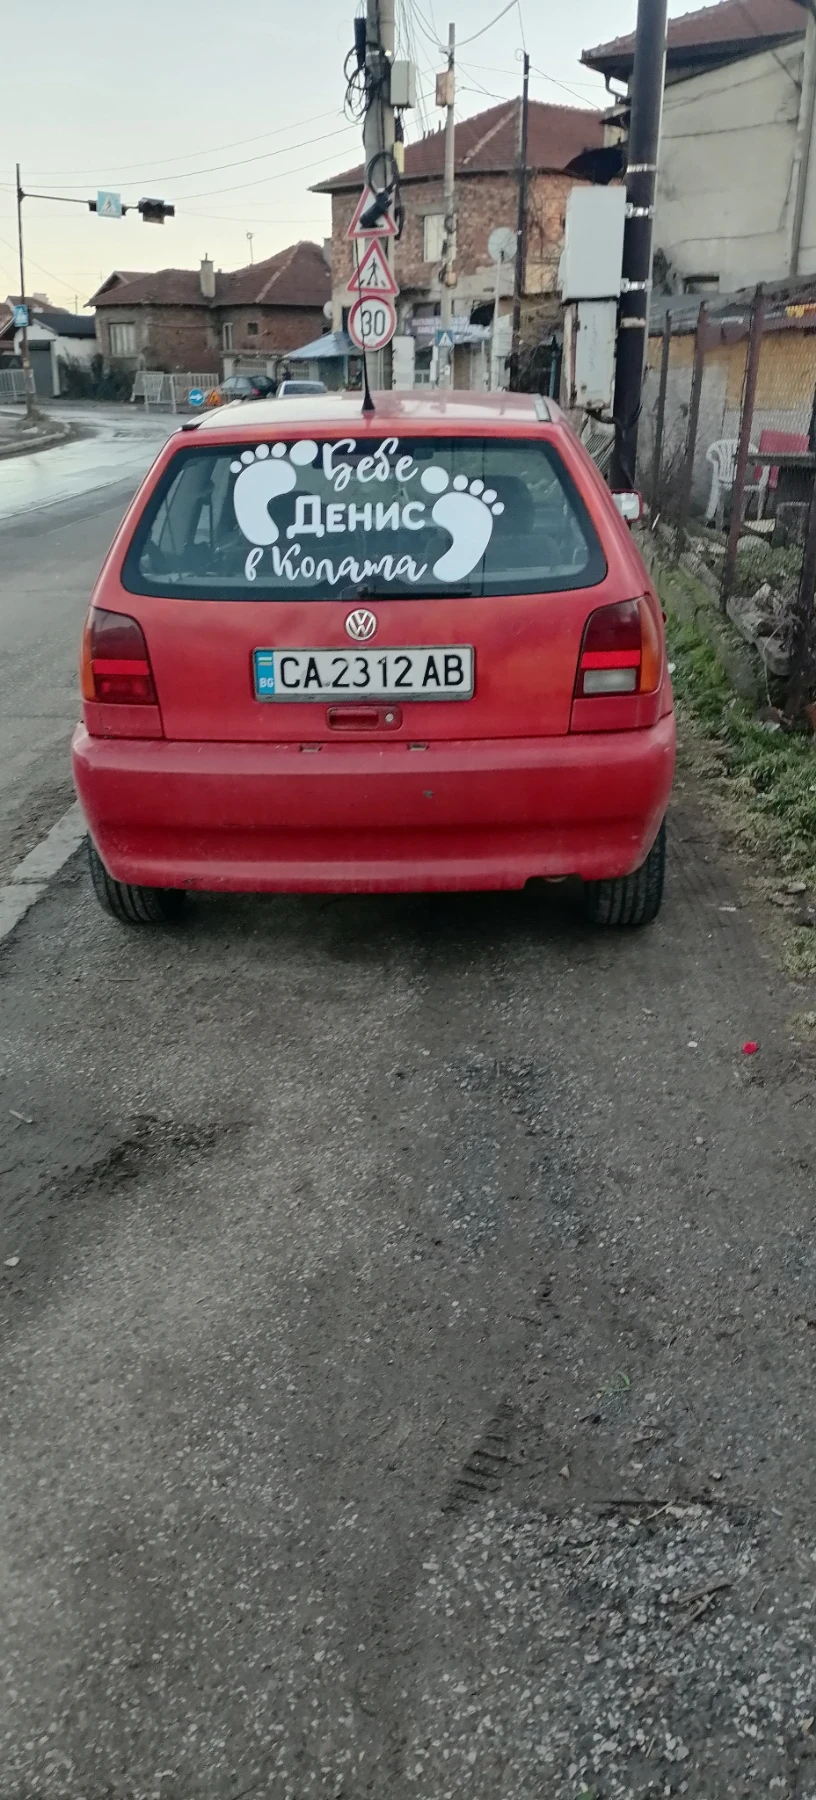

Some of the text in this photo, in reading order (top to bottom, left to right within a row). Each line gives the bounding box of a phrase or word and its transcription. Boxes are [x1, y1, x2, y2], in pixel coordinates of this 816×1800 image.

[361, 310, 386, 337] 30
[322, 437, 418, 492] Бебе
[244, 547, 264, 582] в
[346, 609, 376, 640] VW
[259, 677, 274, 688] BG
[280, 654, 464, 688] CA 2312 AB
